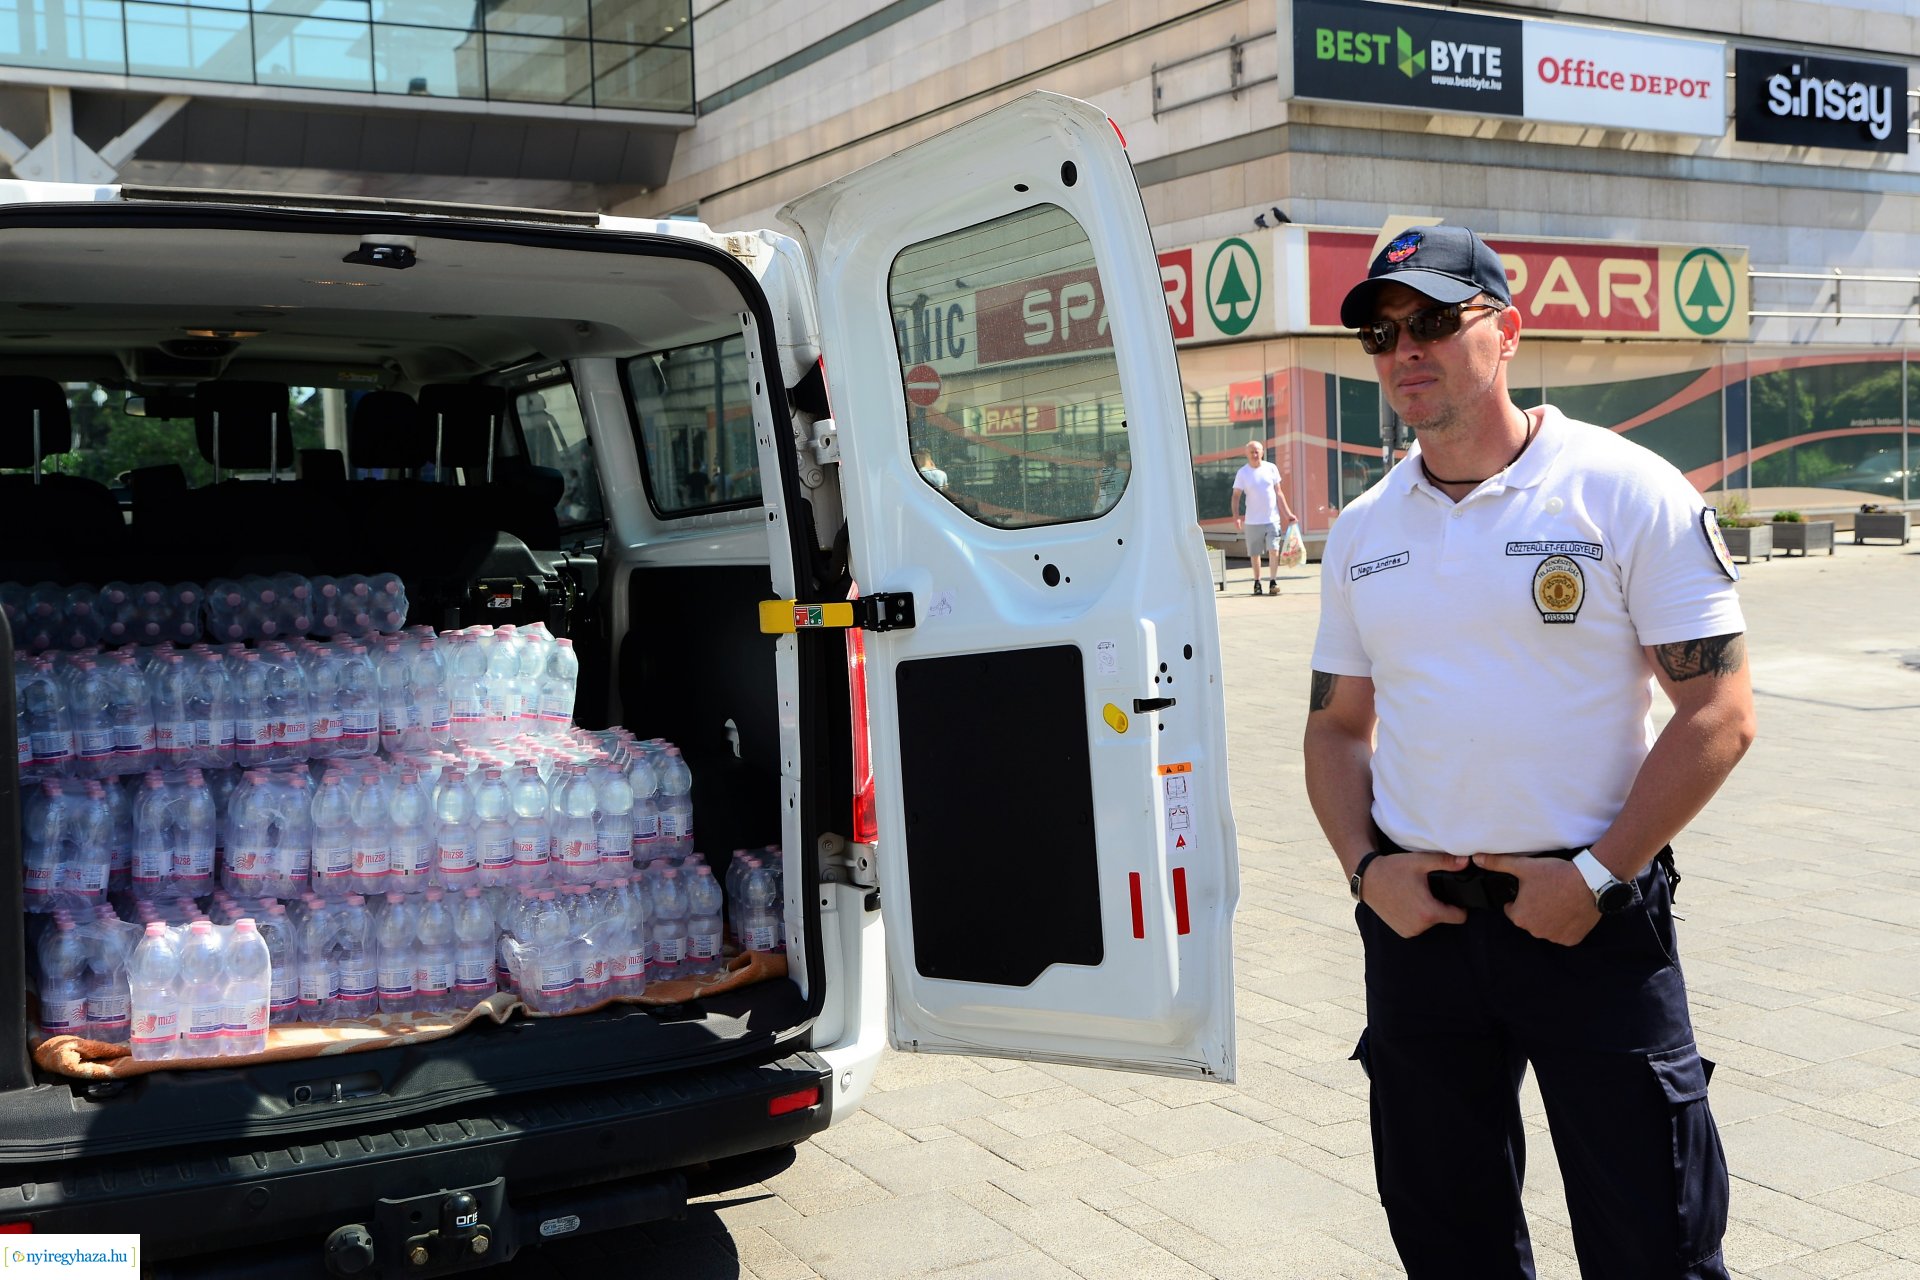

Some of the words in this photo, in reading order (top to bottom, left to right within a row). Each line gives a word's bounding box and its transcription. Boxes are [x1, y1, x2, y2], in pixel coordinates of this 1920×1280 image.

[1316, 28, 1391, 65] BEST
[1431, 40, 1502, 77] BYTE
[1431, 75, 1502, 91] www.bestbyte.hu
[1538, 56, 1624, 92] Office
[1630, 74, 1710, 99] DEPOT
[1768, 64, 1892, 140] sinsay
